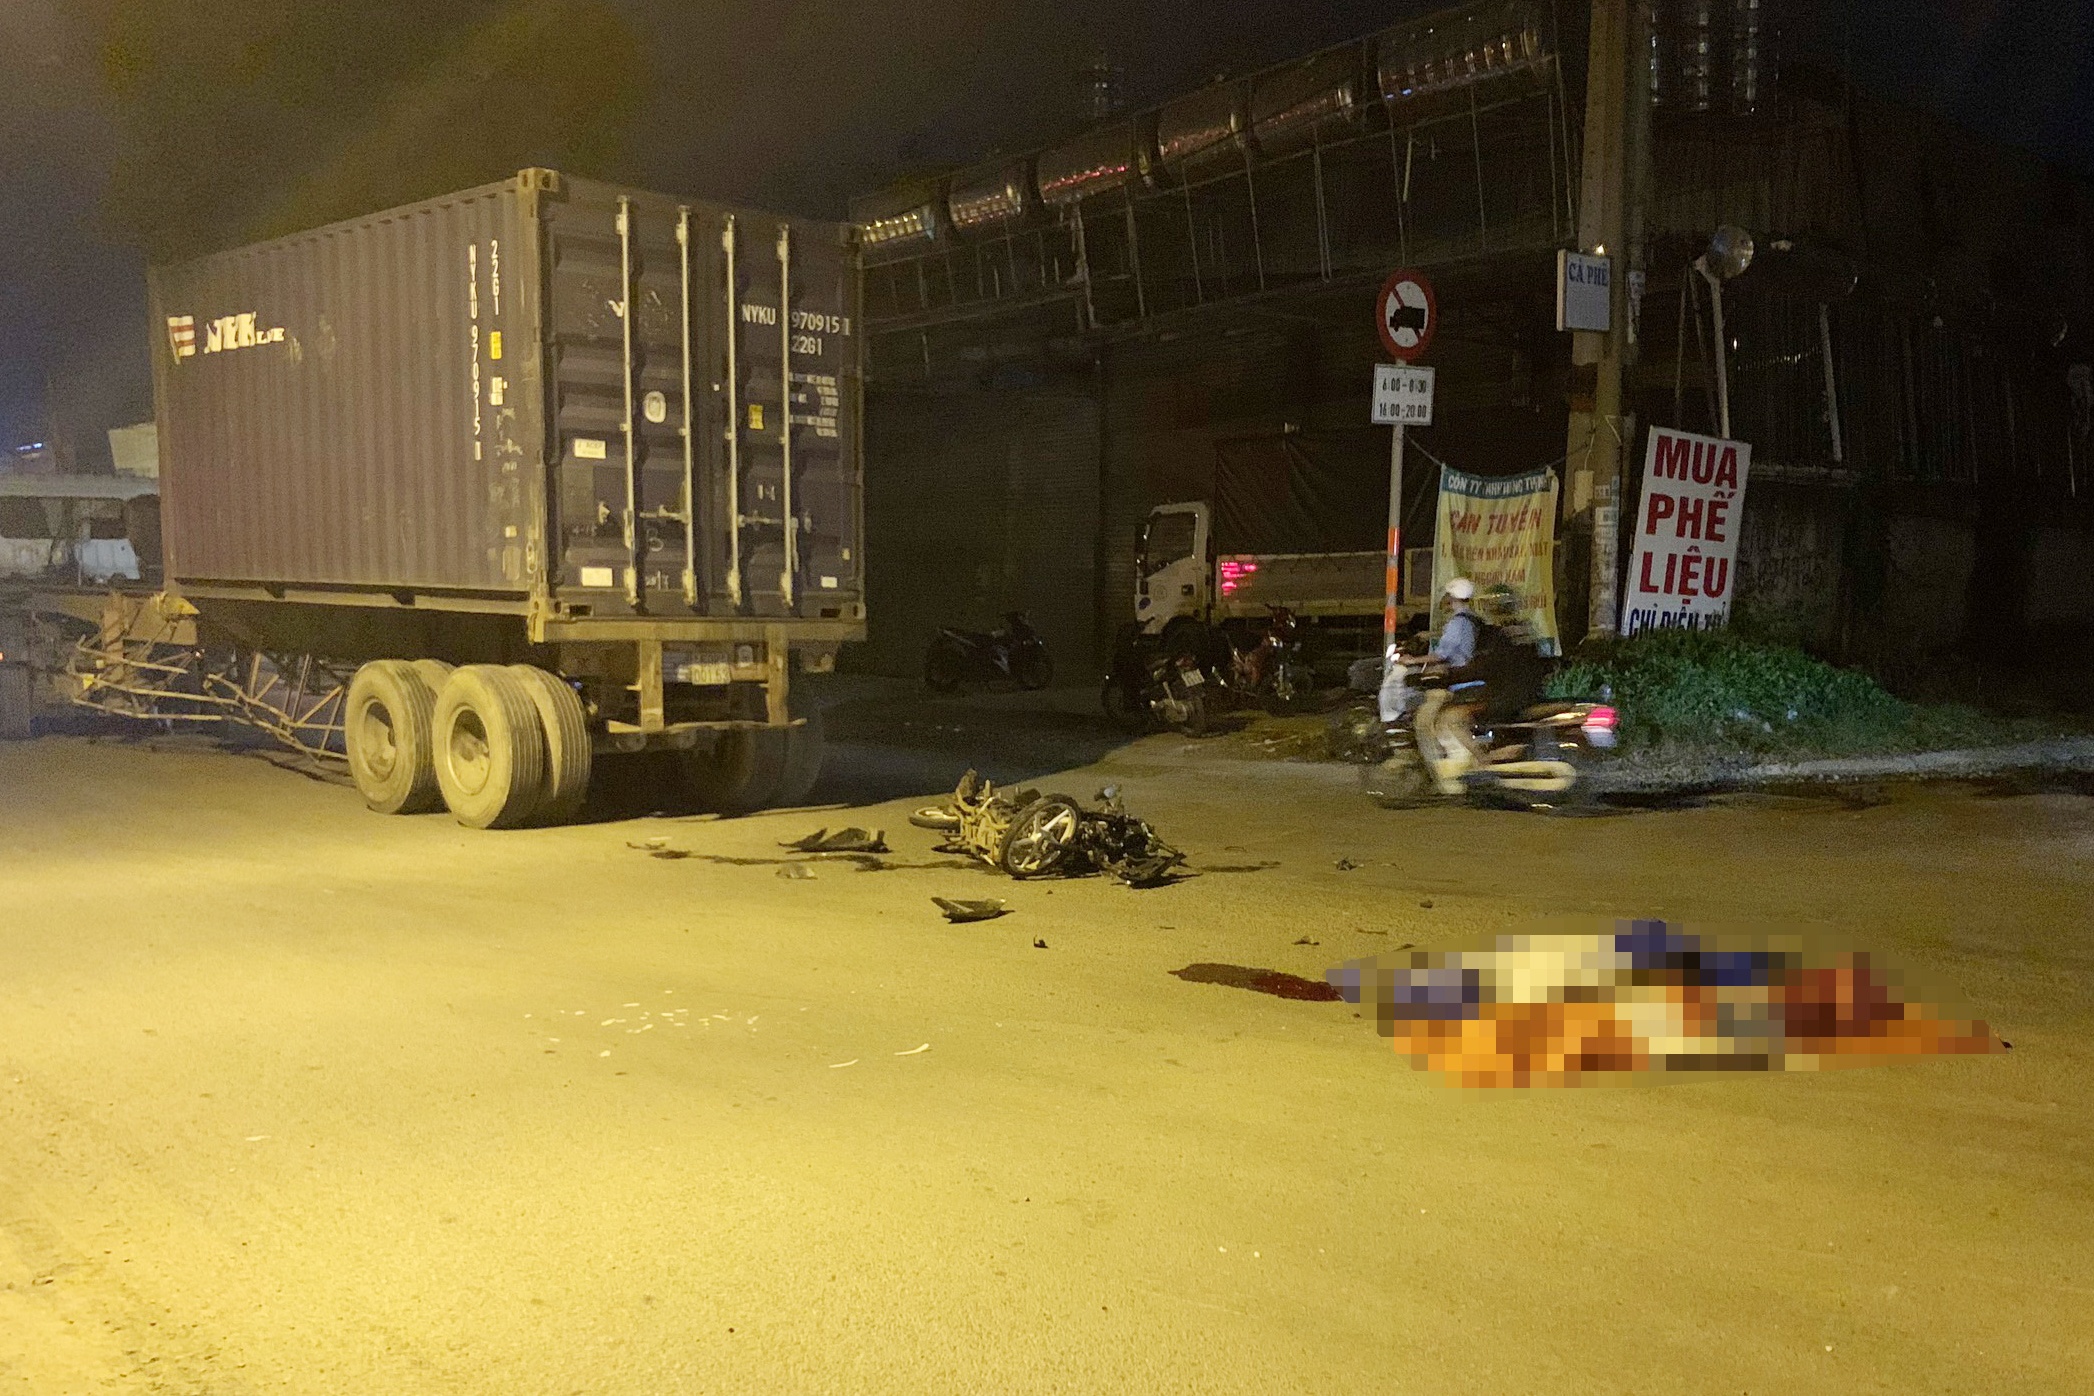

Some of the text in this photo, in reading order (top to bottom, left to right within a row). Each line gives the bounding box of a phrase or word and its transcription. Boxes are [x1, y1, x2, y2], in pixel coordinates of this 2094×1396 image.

[491, 240, 499, 316] 22G1
[204, 311, 256, 354] NYK
[741, 304, 776, 326] NYKU
[791, 311, 840, 334] 970915
[791, 335, 822, 356] 22G1
[471, 325, 480, 435] 970915
[1653, 434, 1738, 490] MUA
[1646, 490, 1738, 543] PHẾ
[1639, 545, 1729, 605] LIỆU
